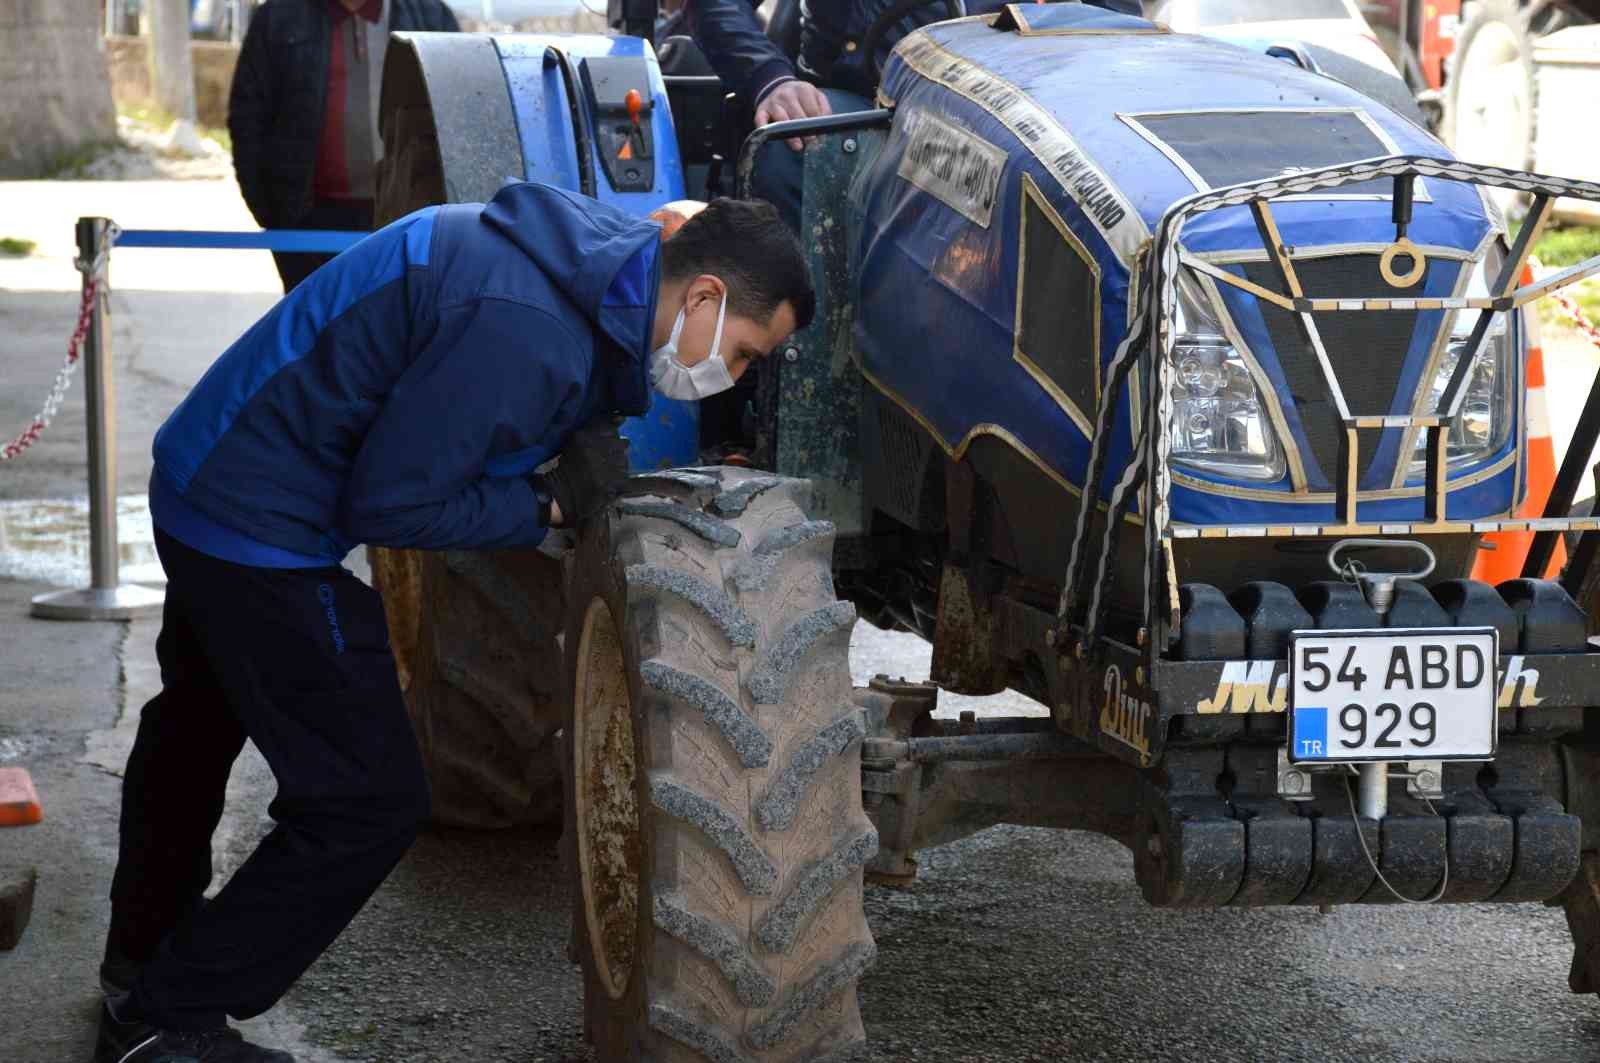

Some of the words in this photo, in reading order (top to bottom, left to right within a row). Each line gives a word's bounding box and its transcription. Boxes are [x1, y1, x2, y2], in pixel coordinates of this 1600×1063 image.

[1302, 645, 1367, 692] 54
[1384, 644, 1485, 690] ABD
[1302, 740, 1322, 755] TR
[1339, 702, 1437, 749] 929
